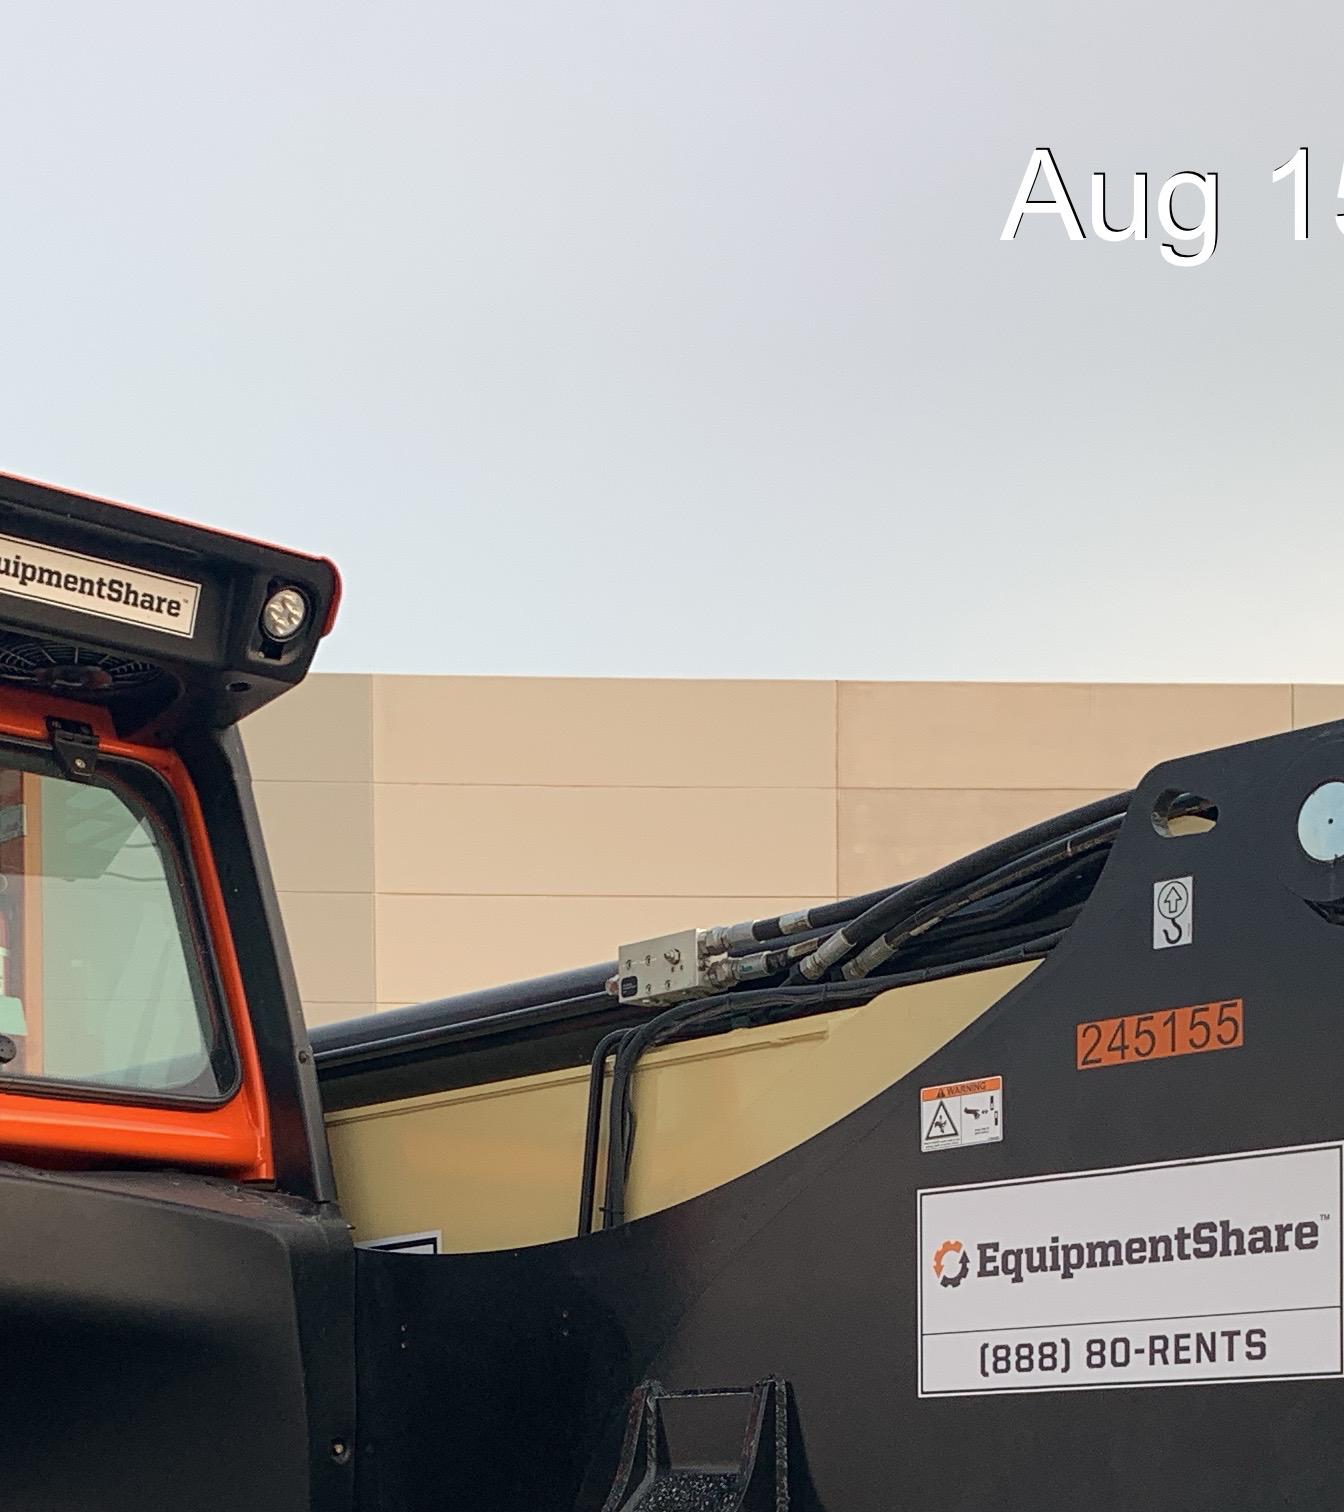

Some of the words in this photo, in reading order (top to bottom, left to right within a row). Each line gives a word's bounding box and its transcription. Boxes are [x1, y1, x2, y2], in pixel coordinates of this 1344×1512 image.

[1081, 1001, 1241, 1066] 245155
[947, 1081, 986, 1095] WARNING
[976, 1218, 1320, 1284] EquipmentShare
[979, 1337, 1071, 1378] (888)
[1086, 1328, 1268, 1370] 80-RENTS
